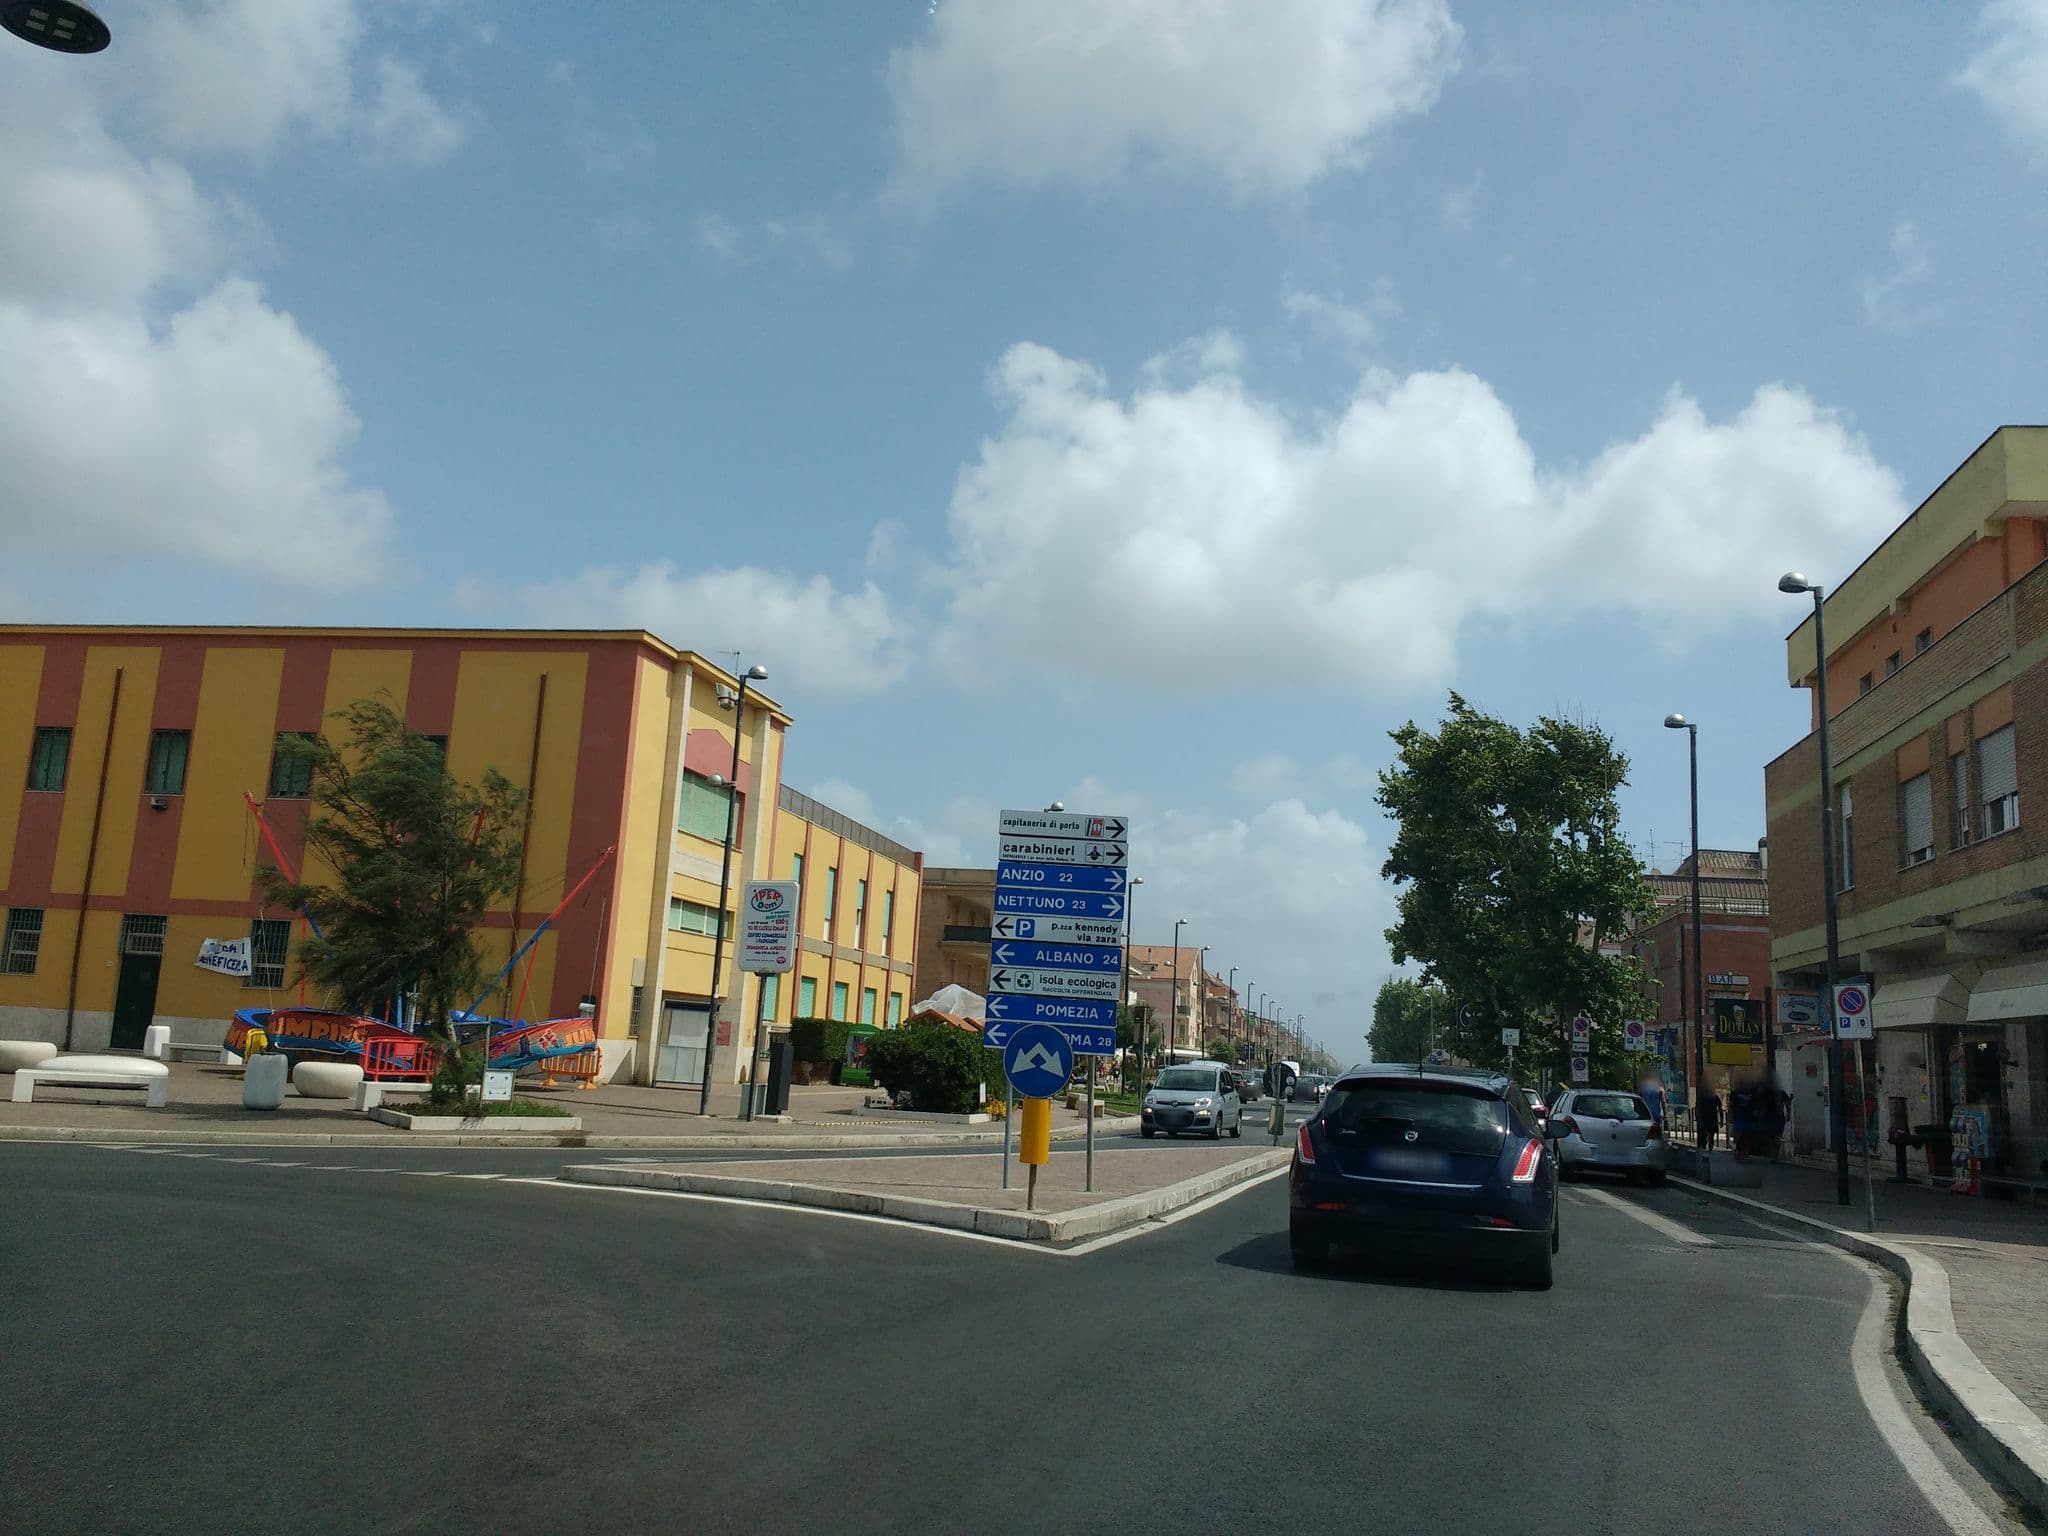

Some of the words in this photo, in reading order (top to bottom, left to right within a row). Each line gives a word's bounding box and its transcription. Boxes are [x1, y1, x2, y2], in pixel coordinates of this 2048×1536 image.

[1003, 817, 1046, 828] capitaneria
[1049, 820, 1056, 828] di
[1059, 822, 1080, 831] porto
[1003, 843, 1075, 856] carabinieri
[1001, 868, 1045, 881] ANZIO
[1058, 873, 1073, 882] 22
[998, 895, 1065, 909] NETTUNO
[1072, 900, 1086, 910] 23
[1019, 920, 1031, 936] P
[1075, 923, 1118, 935] kennedy
[1077, 934, 1091, 942] via
[1096, 935, 1117, 943] zara
[1036, 950, 1094, 964] ALBANO
[1103, 955, 1119, 965] 24
[1039, 974, 1064, 985] isola
[1067, 977, 1117, 990] ecologica
[1711, 975, 1734, 984] BAR
[1042, 986, 1071, 994] RACCOLTA
[1036, 1004, 1099, 1019] POMEZIA
[1107, 1009, 1114, 1019] 7
[1098, 1037, 1112, 1047] 28
